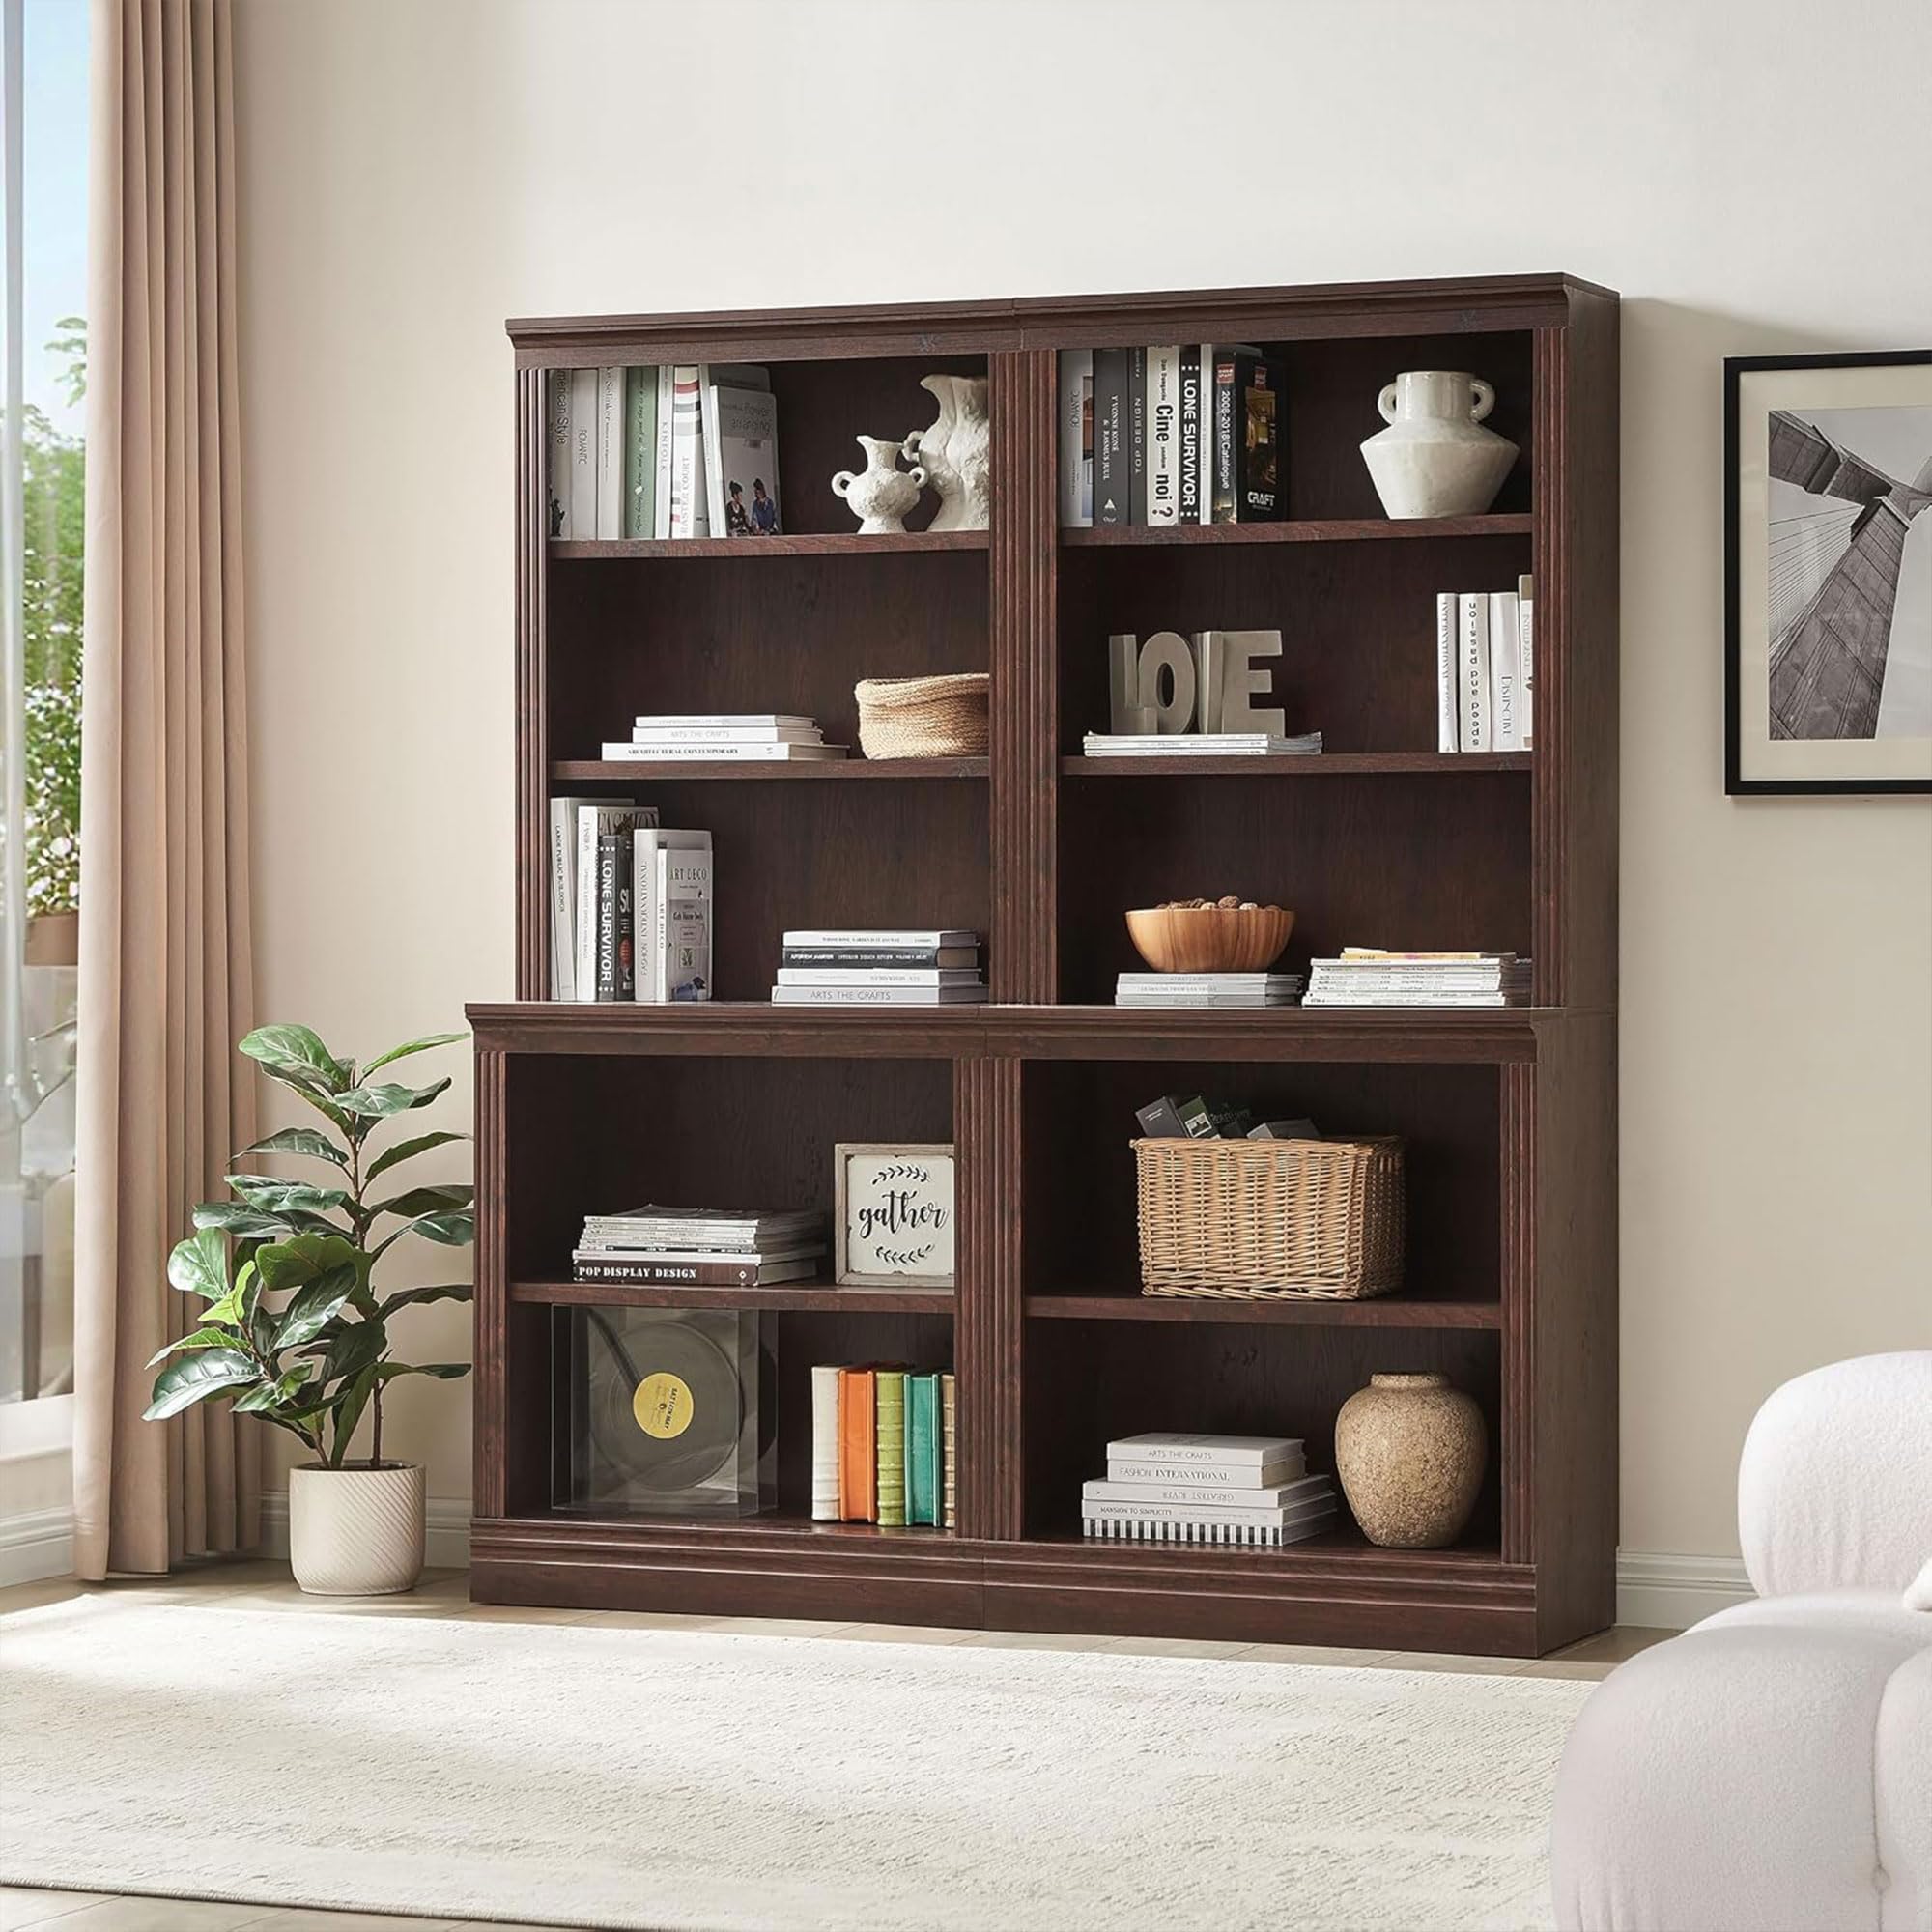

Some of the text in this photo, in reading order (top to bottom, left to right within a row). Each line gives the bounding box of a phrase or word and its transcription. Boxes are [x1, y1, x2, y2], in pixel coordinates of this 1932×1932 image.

[555, 417, 570, 444] Style
[1155, 405, 1173, 441] Cine
[1183, 379, 1196, 506] LONE SURVIVOR
[1155, 474, 1172, 500] noi
[1247, 491, 1275, 507] CRAFT
[670, 868, 707, 880] ART DECO
[601, 860, 612, 981] LONE SURVIVOR
[810, 991, 891, 1000] ARTS THE CRAFTS
[858, 1189, 947, 1239] gather
[579, 1266, 696, 1279] POP DISPLAY DESIGN
[1185, 1451, 1212, 1460] CRAFTS
[1120, 1467, 1230, 1481] FASHION INTERNATIONAL
